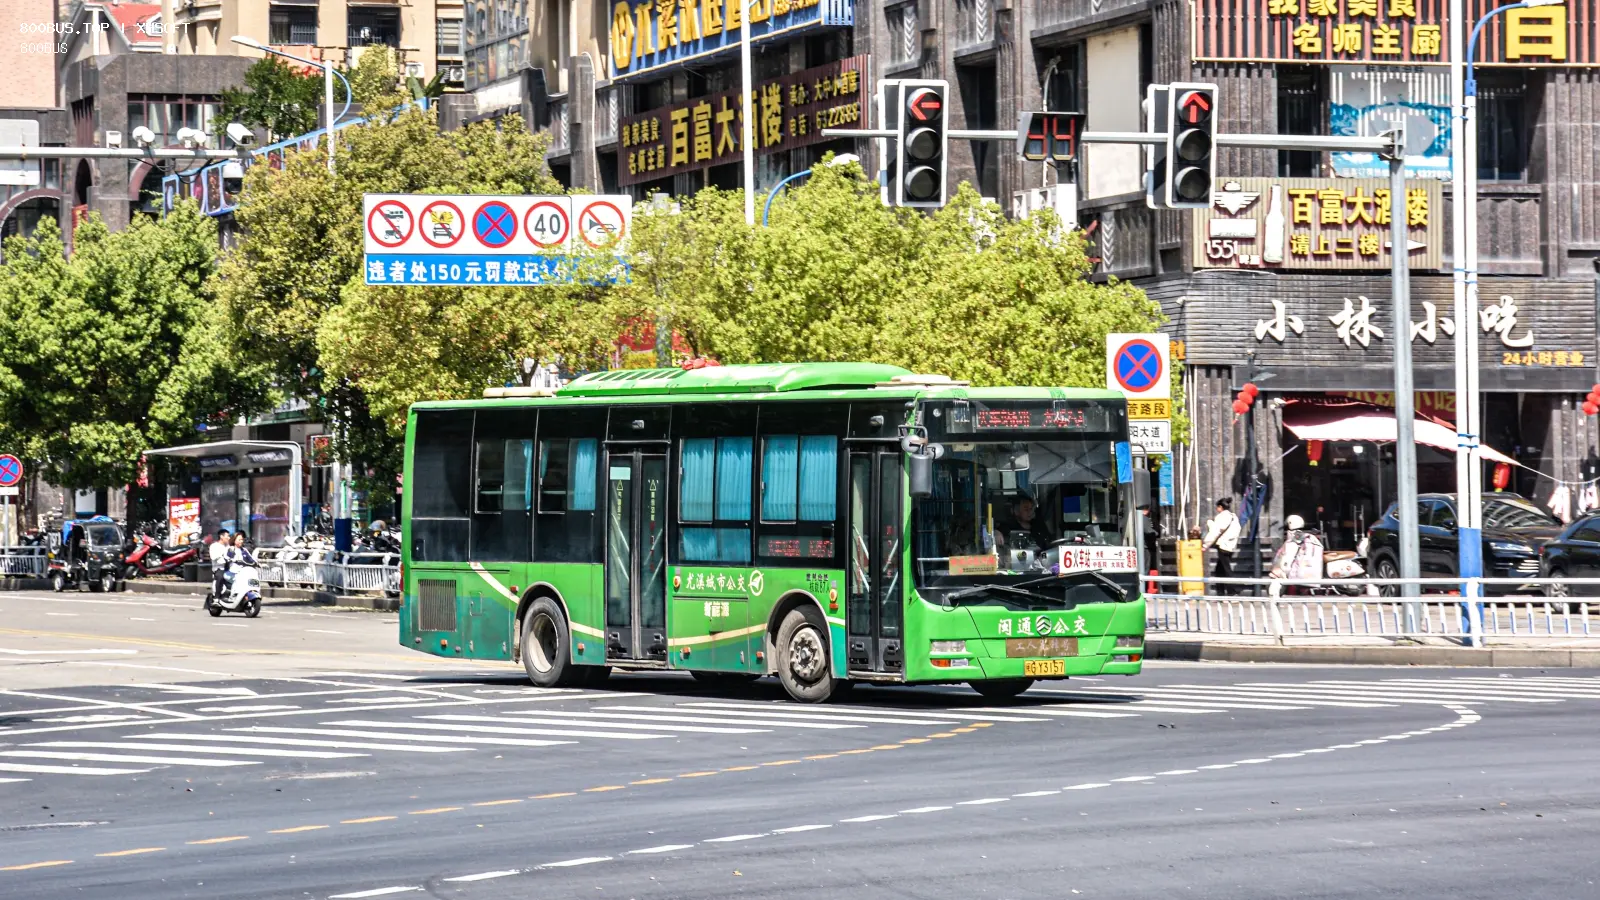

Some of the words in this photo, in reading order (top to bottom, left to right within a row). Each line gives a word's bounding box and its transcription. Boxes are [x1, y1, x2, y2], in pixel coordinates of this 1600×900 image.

[1293, 23, 1441, 55] 名师主厨
[1288, 187, 1429, 226] 百富大酒楼
[534, 213, 561, 236] 40
[1204, 239, 1239, 259] 1551
[1291, 234, 1380, 256] 请上二楼
[1255, 295, 1535, 347] 小林小吃
[1502, 351, 1584, 367] 24小时营业
[1063, 550, 1073, 569] 6
[686, 572, 747, 592] 尤溪城市公交
[998, 616, 1034, 636] 闽通
[1053, 615, 1089, 635] 公交
